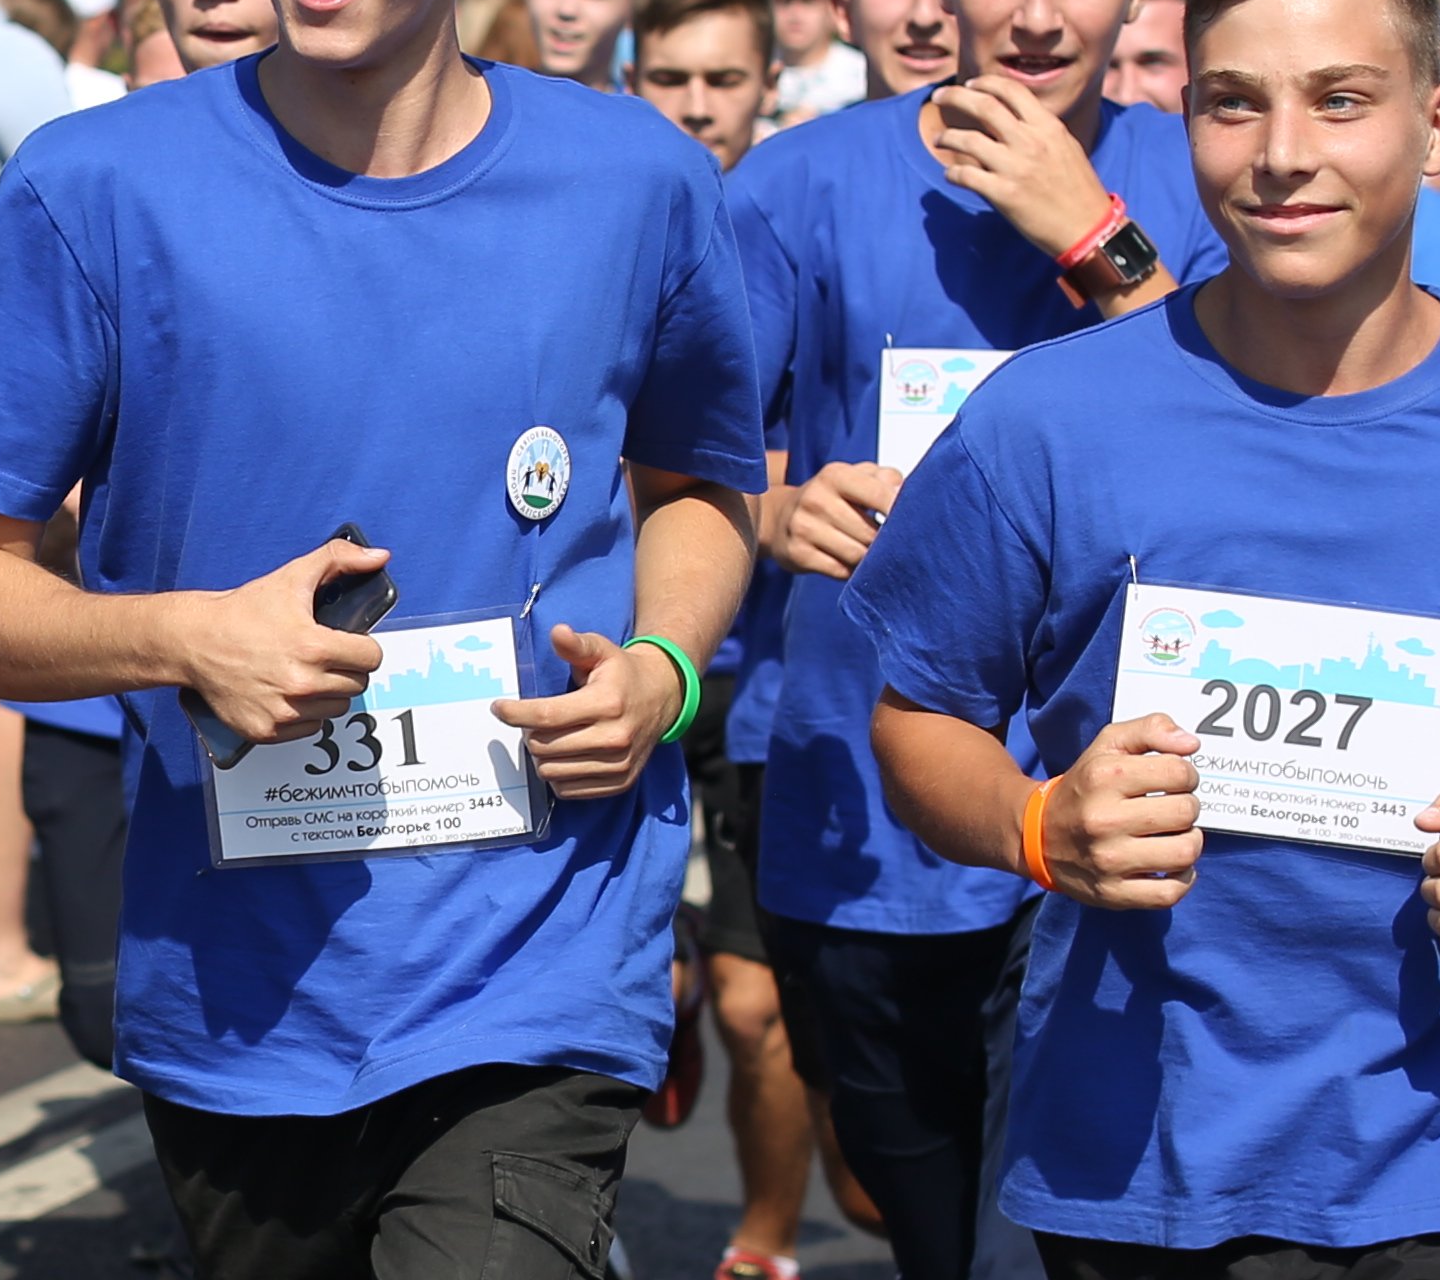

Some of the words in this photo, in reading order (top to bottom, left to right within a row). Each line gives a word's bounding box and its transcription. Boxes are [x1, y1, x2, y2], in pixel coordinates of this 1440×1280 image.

[1195, 678, 1374, 751] 2027
[304, 708, 426, 776] 331
[265, 775, 479, 802] #бежимчтобыпомочь
[1199, 781, 1230, 796] СМС
[1233, 787, 1249, 798] на
[1252, 790, 1317, 805] короткий
[1320, 798, 1366, 813] номер
[1370, 801, 1406, 816] 3443
[245, 815, 301, 828] Отправь
[303, 810, 334, 824] СМС
[337, 811, 353, 821] на
[355, 805, 417, 821] короткий
[420, 802, 464, 814] номер
[468, 795, 502, 809] 3443
[1198, 801, 1246, 814] екстом
[1250, 804, 1326, 824] Белогорье
[1333, 814, 1359, 828] 100
[301, 829, 354, 840] текстом
[356, 822, 430, 837] Белогорье
[435, 816, 461, 829] 100
[420, 833, 437, 842] 100
[1314, 827, 1331, 837] 100
